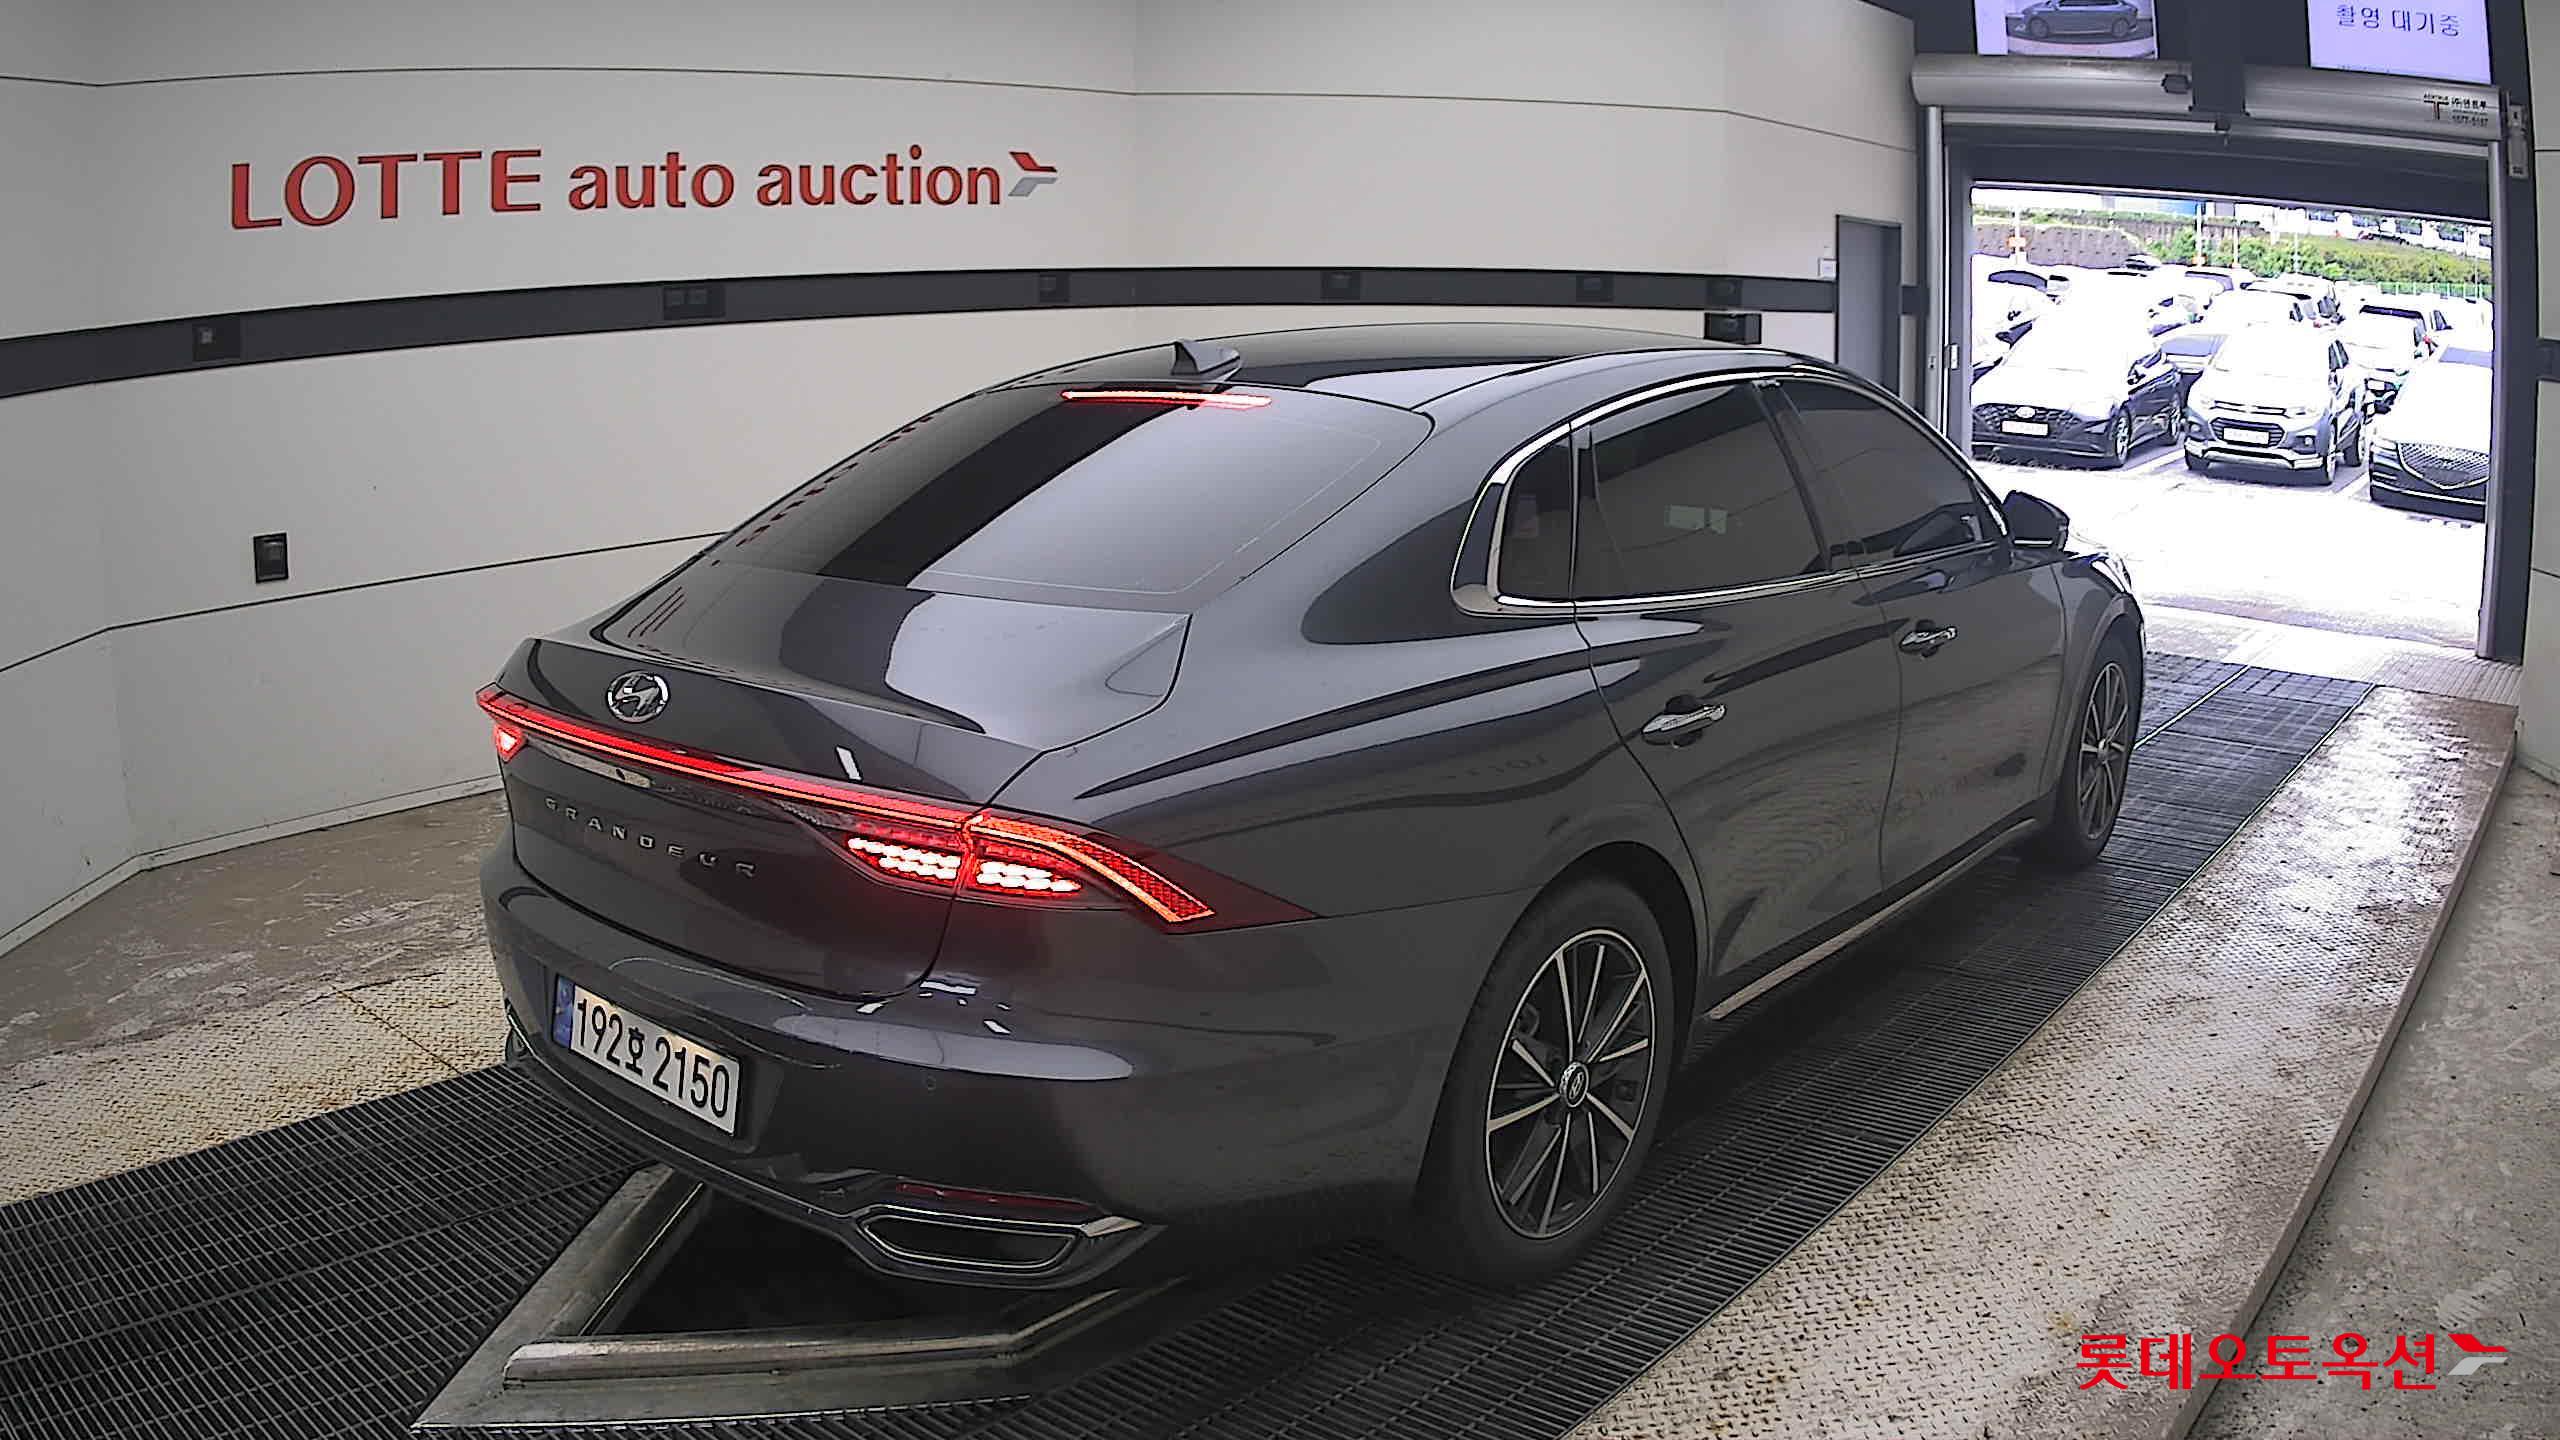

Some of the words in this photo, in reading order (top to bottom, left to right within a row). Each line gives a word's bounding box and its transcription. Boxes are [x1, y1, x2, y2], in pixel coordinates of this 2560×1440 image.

[2392, 9, 2459, 37] 대기중
[230, 148, 542, 231] LOTTE
[568, 151, 735, 209] auto
[756, 145, 1001, 206] auction
[545, 797, 756, 877] GRANDEUR
[577, 998, 645, 1077] 192호
[652, 1036, 730, 1118] 2150
